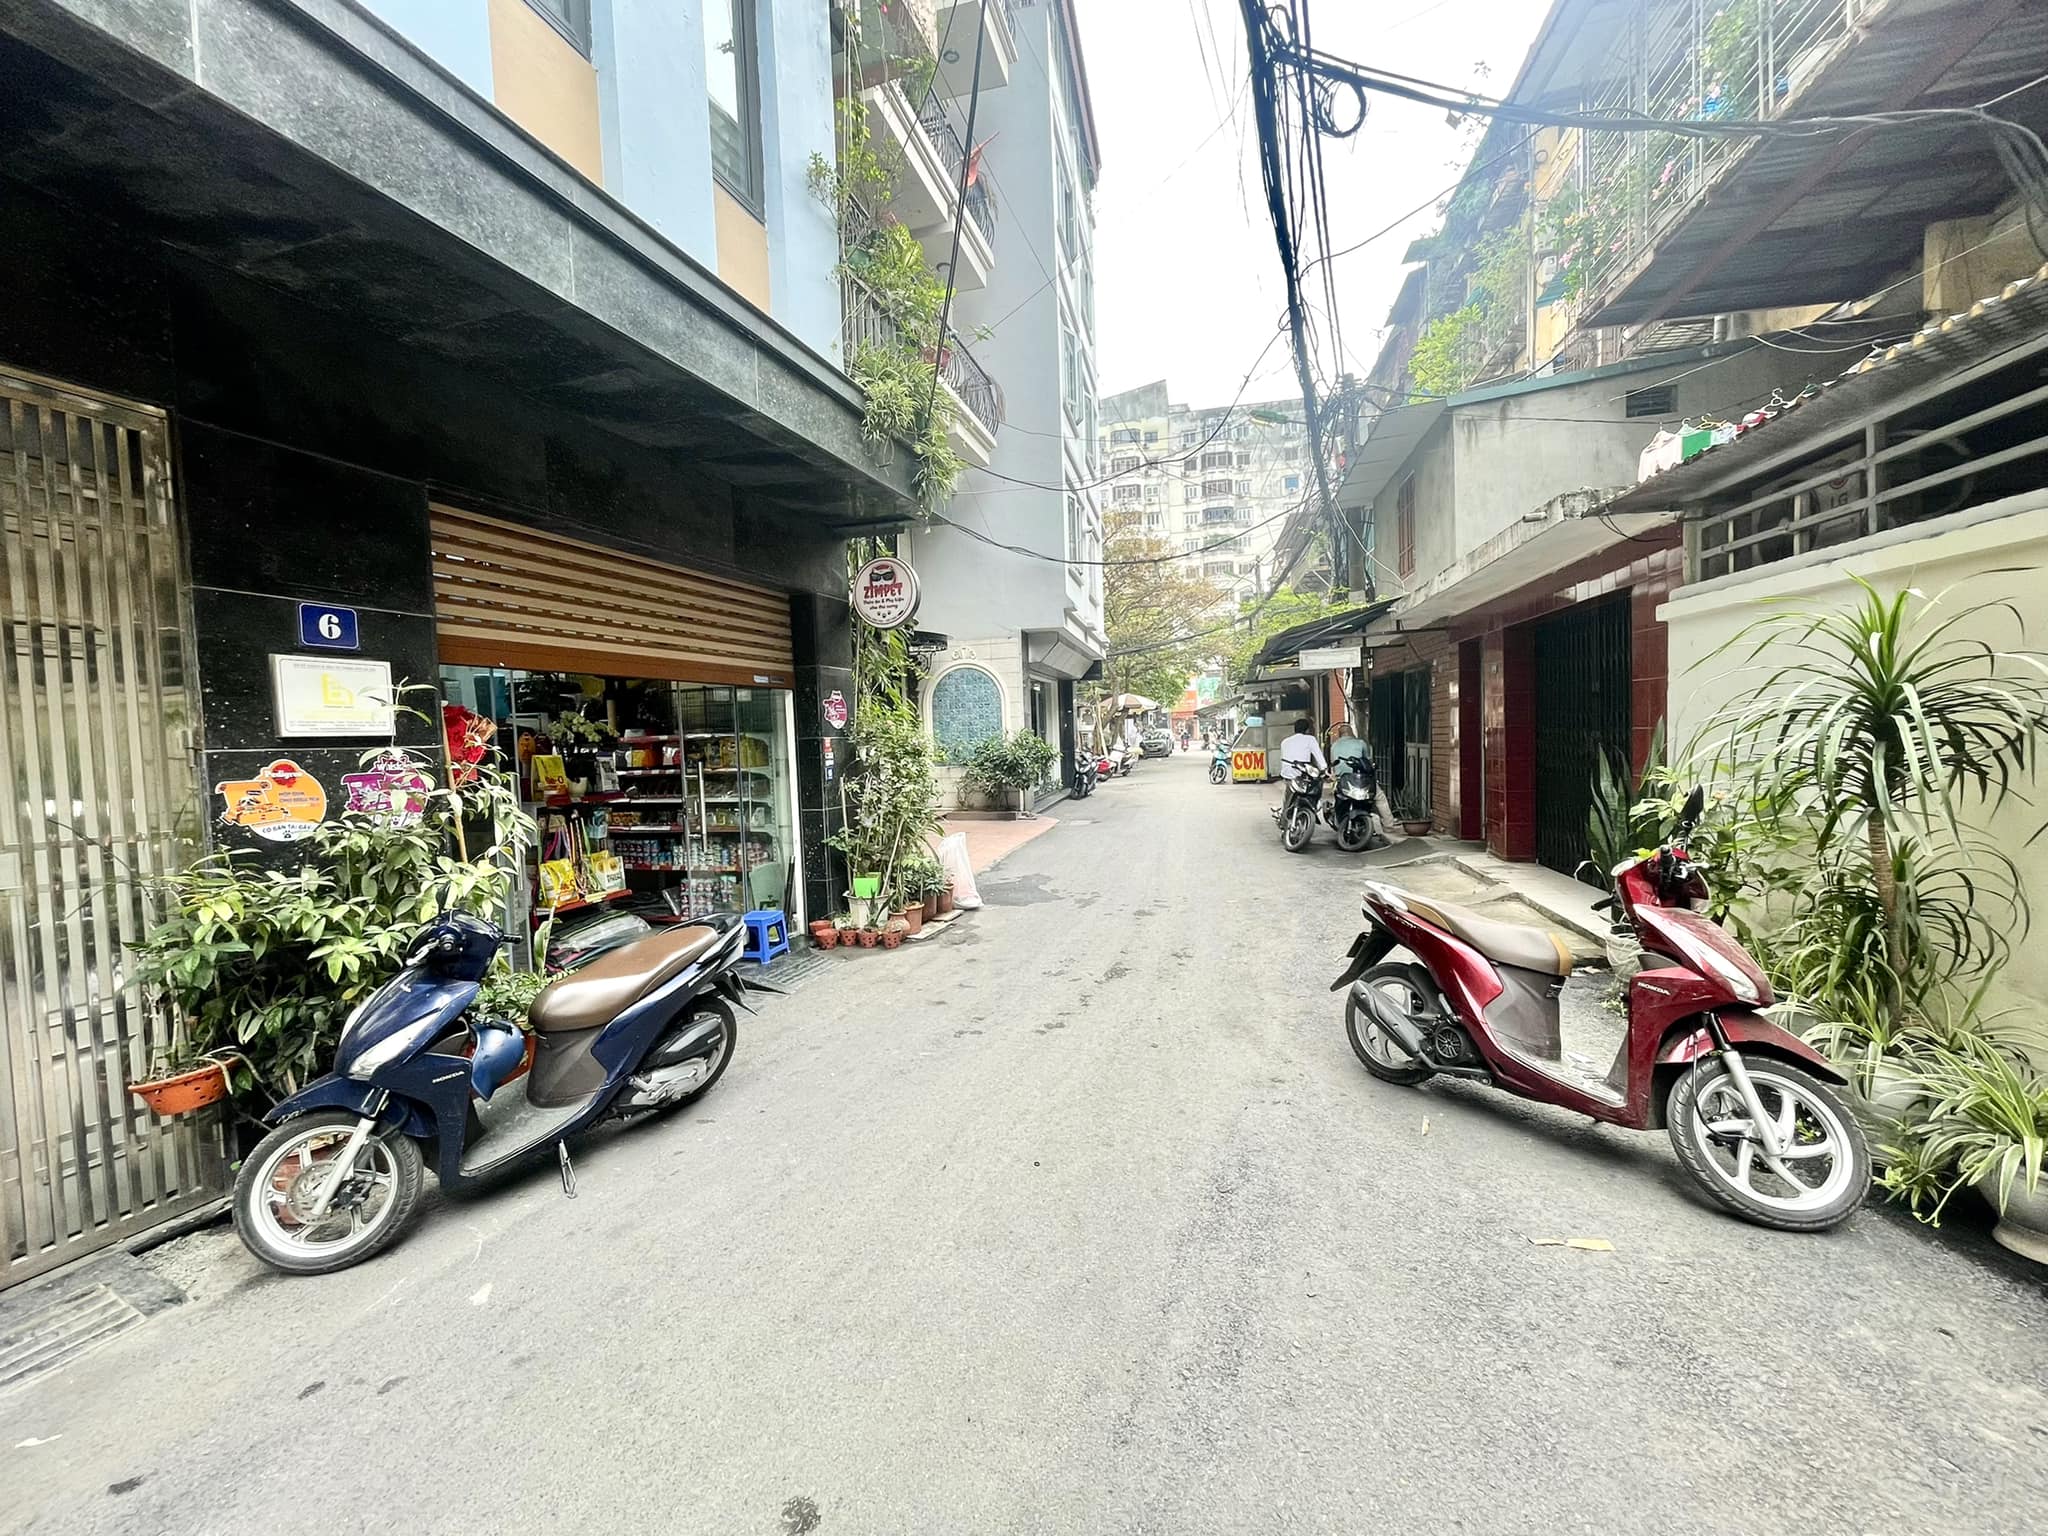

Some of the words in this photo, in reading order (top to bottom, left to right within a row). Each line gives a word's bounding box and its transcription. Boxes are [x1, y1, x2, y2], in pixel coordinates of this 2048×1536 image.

[864, 582, 903, 599] ZIMPET
[318, 613, 342, 640] 6
[1234, 751, 1265, 770] CƠM
[1637, 981, 1671, 996] HONDA
[431, 1070, 466, 1084] HONDA
